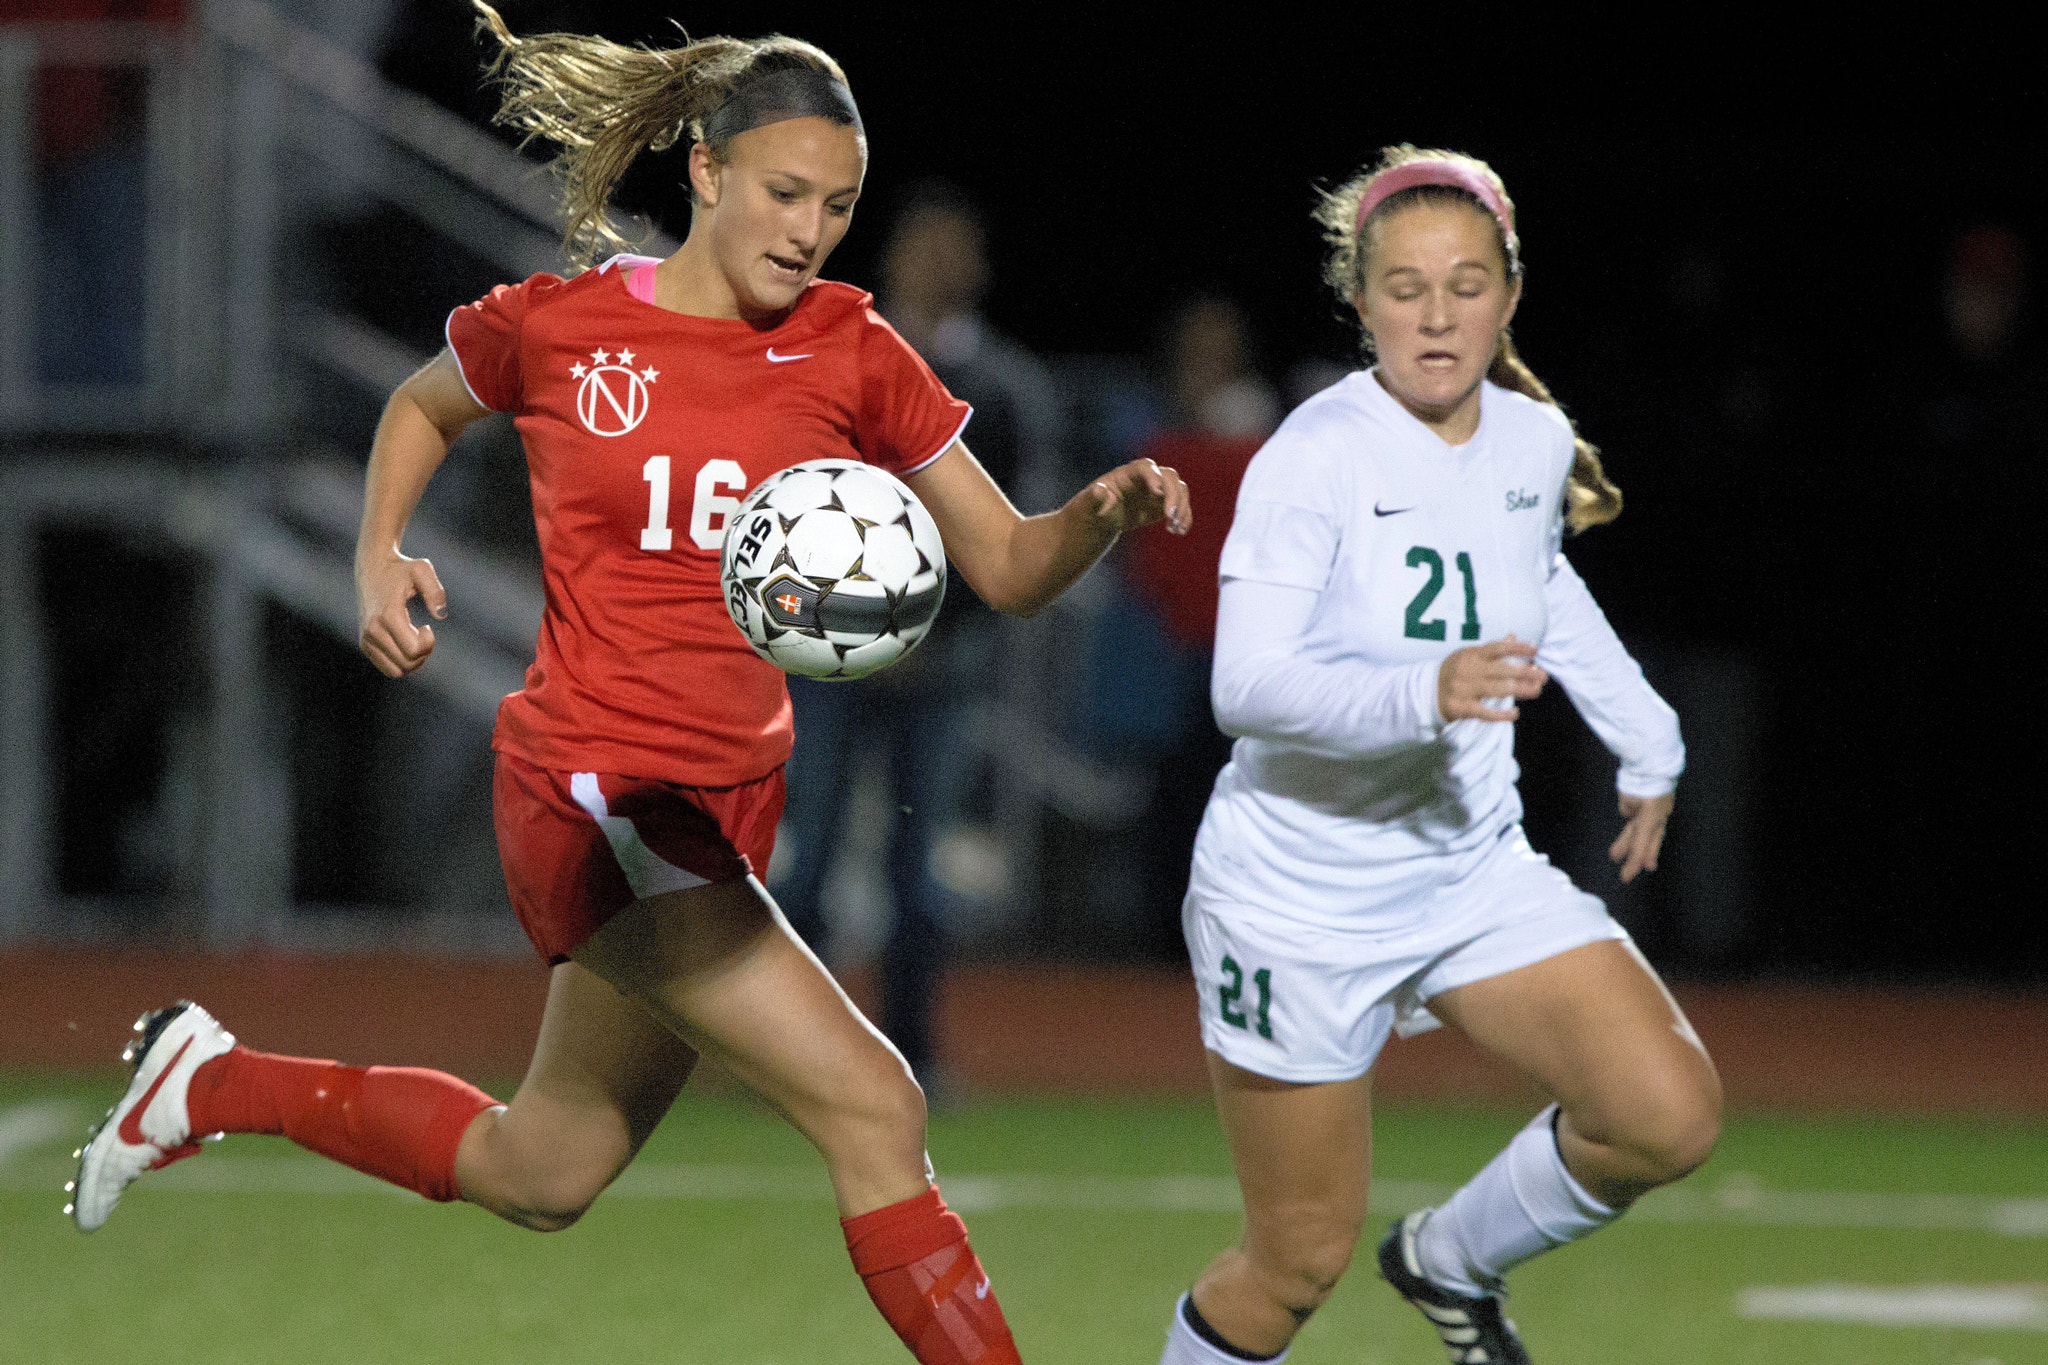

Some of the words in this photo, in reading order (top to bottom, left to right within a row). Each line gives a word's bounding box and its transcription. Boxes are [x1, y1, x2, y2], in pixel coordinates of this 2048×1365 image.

[585, 367, 639, 432] N
[640, 455, 747, 550] 16
[1404, 545, 1481, 641] 21
[1219, 954, 1272, 1039] 21
